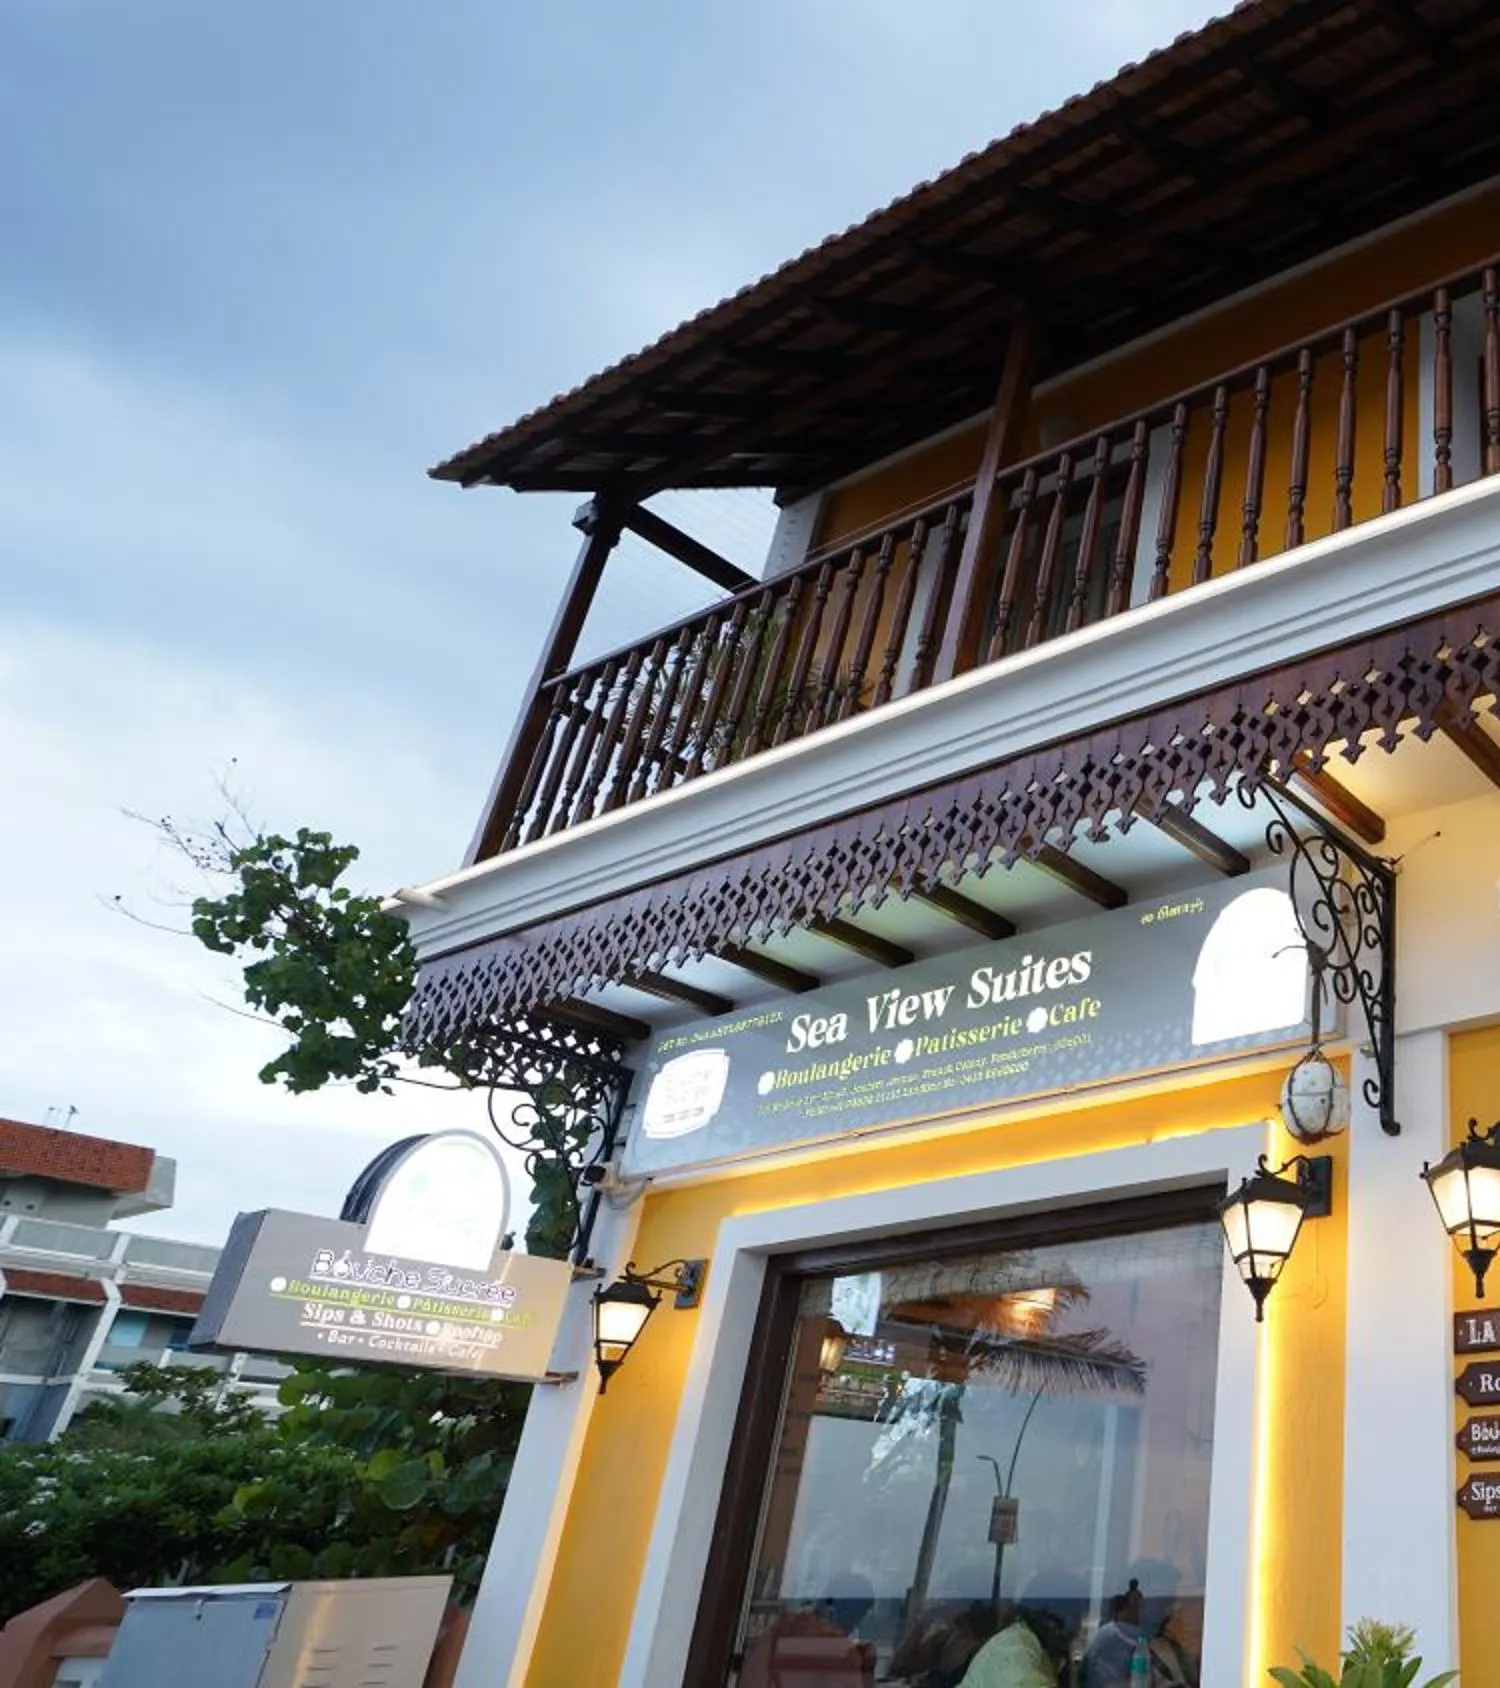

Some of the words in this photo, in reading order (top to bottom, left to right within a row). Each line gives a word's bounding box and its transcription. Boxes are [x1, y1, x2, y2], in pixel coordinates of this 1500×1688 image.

[786, 1011, 848, 1053] Sea
[866, 984, 956, 1034] View
[966, 950, 1093, 1009] Suites
[775, 1045, 892, 1090] Boulangerie
[915, 1015, 1023, 1057] Patisserie
[288, 1279, 395, 1307] Boulangerie
[302, 1303, 345, 1324] Sips
[349, 1309, 367, 1326] &
[372, 1311, 425, 1333] Shots
[1465, 1318, 1497, 1345] LA
[327, 1329, 356, 1345] Bar
